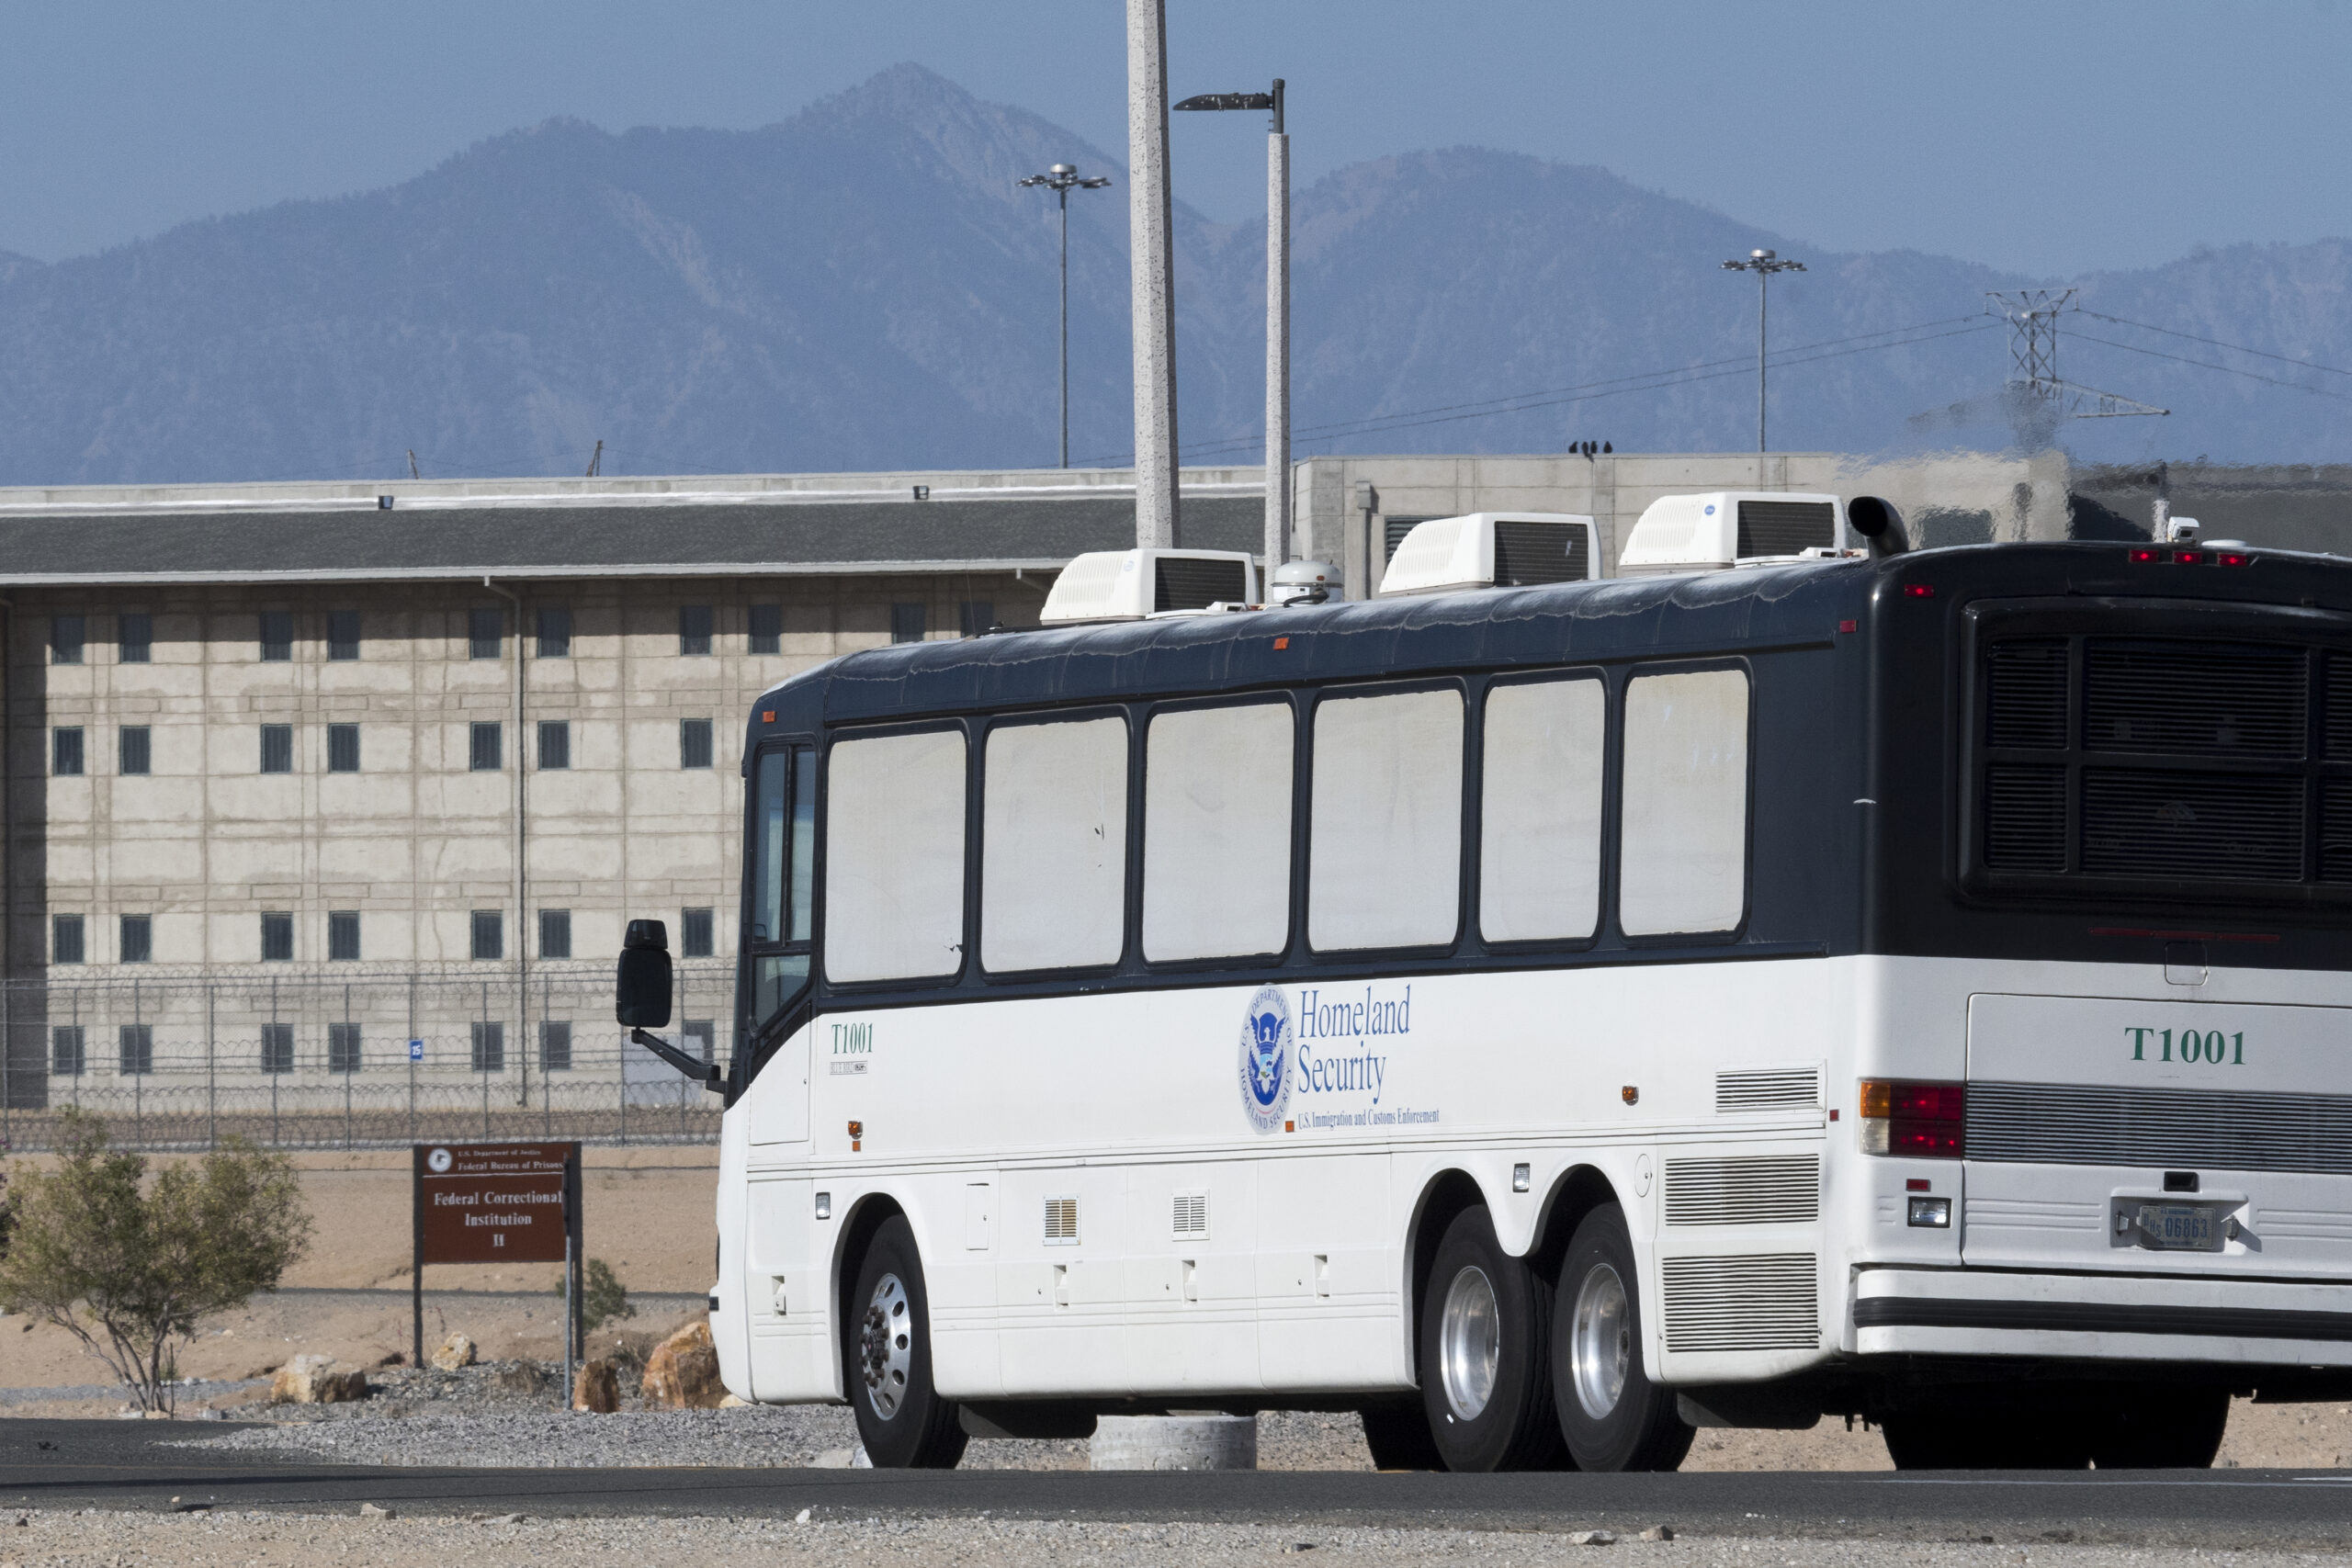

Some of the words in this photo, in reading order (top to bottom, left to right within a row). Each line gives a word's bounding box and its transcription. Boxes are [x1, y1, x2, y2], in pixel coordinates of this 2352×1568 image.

[1250, 988, 1290, 1023] DEPARTMENT
[1298, 983, 1411, 1038] Homeland
[831, 1022, 873, 1054] T1001
[2124, 1027, 2246, 1065] T1001
[1298, 1040, 1386, 1104] Security
[1240, 1068, 1268, 1130] HOMELAND
[1269, 1067, 1292, 1129] SECURITY
[1298, 1111, 1311, 1130] U.S.
[1312, 1111, 1352, 1131] Immigration
[1354, 1109, 1366, 1125] and
[1368, 1108, 1396, 1125] Customs
[1397, 1108, 1440, 1124] Enforcement
[458, 1162, 487, 1170] Federal
[491, 1161, 519, 1169] Bureau
[522, 1160, 531, 1169] of
[533, 1160, 564, 1169] Prisons
[434, 1192, 479, 1205] Federal
[484, 1190, 562, 1204] Correctional
[465, 1213, 532, 1226] Institution
[2165, 1217, 2207, 1237] 06863
[492, 1234, 504, 1247] II
